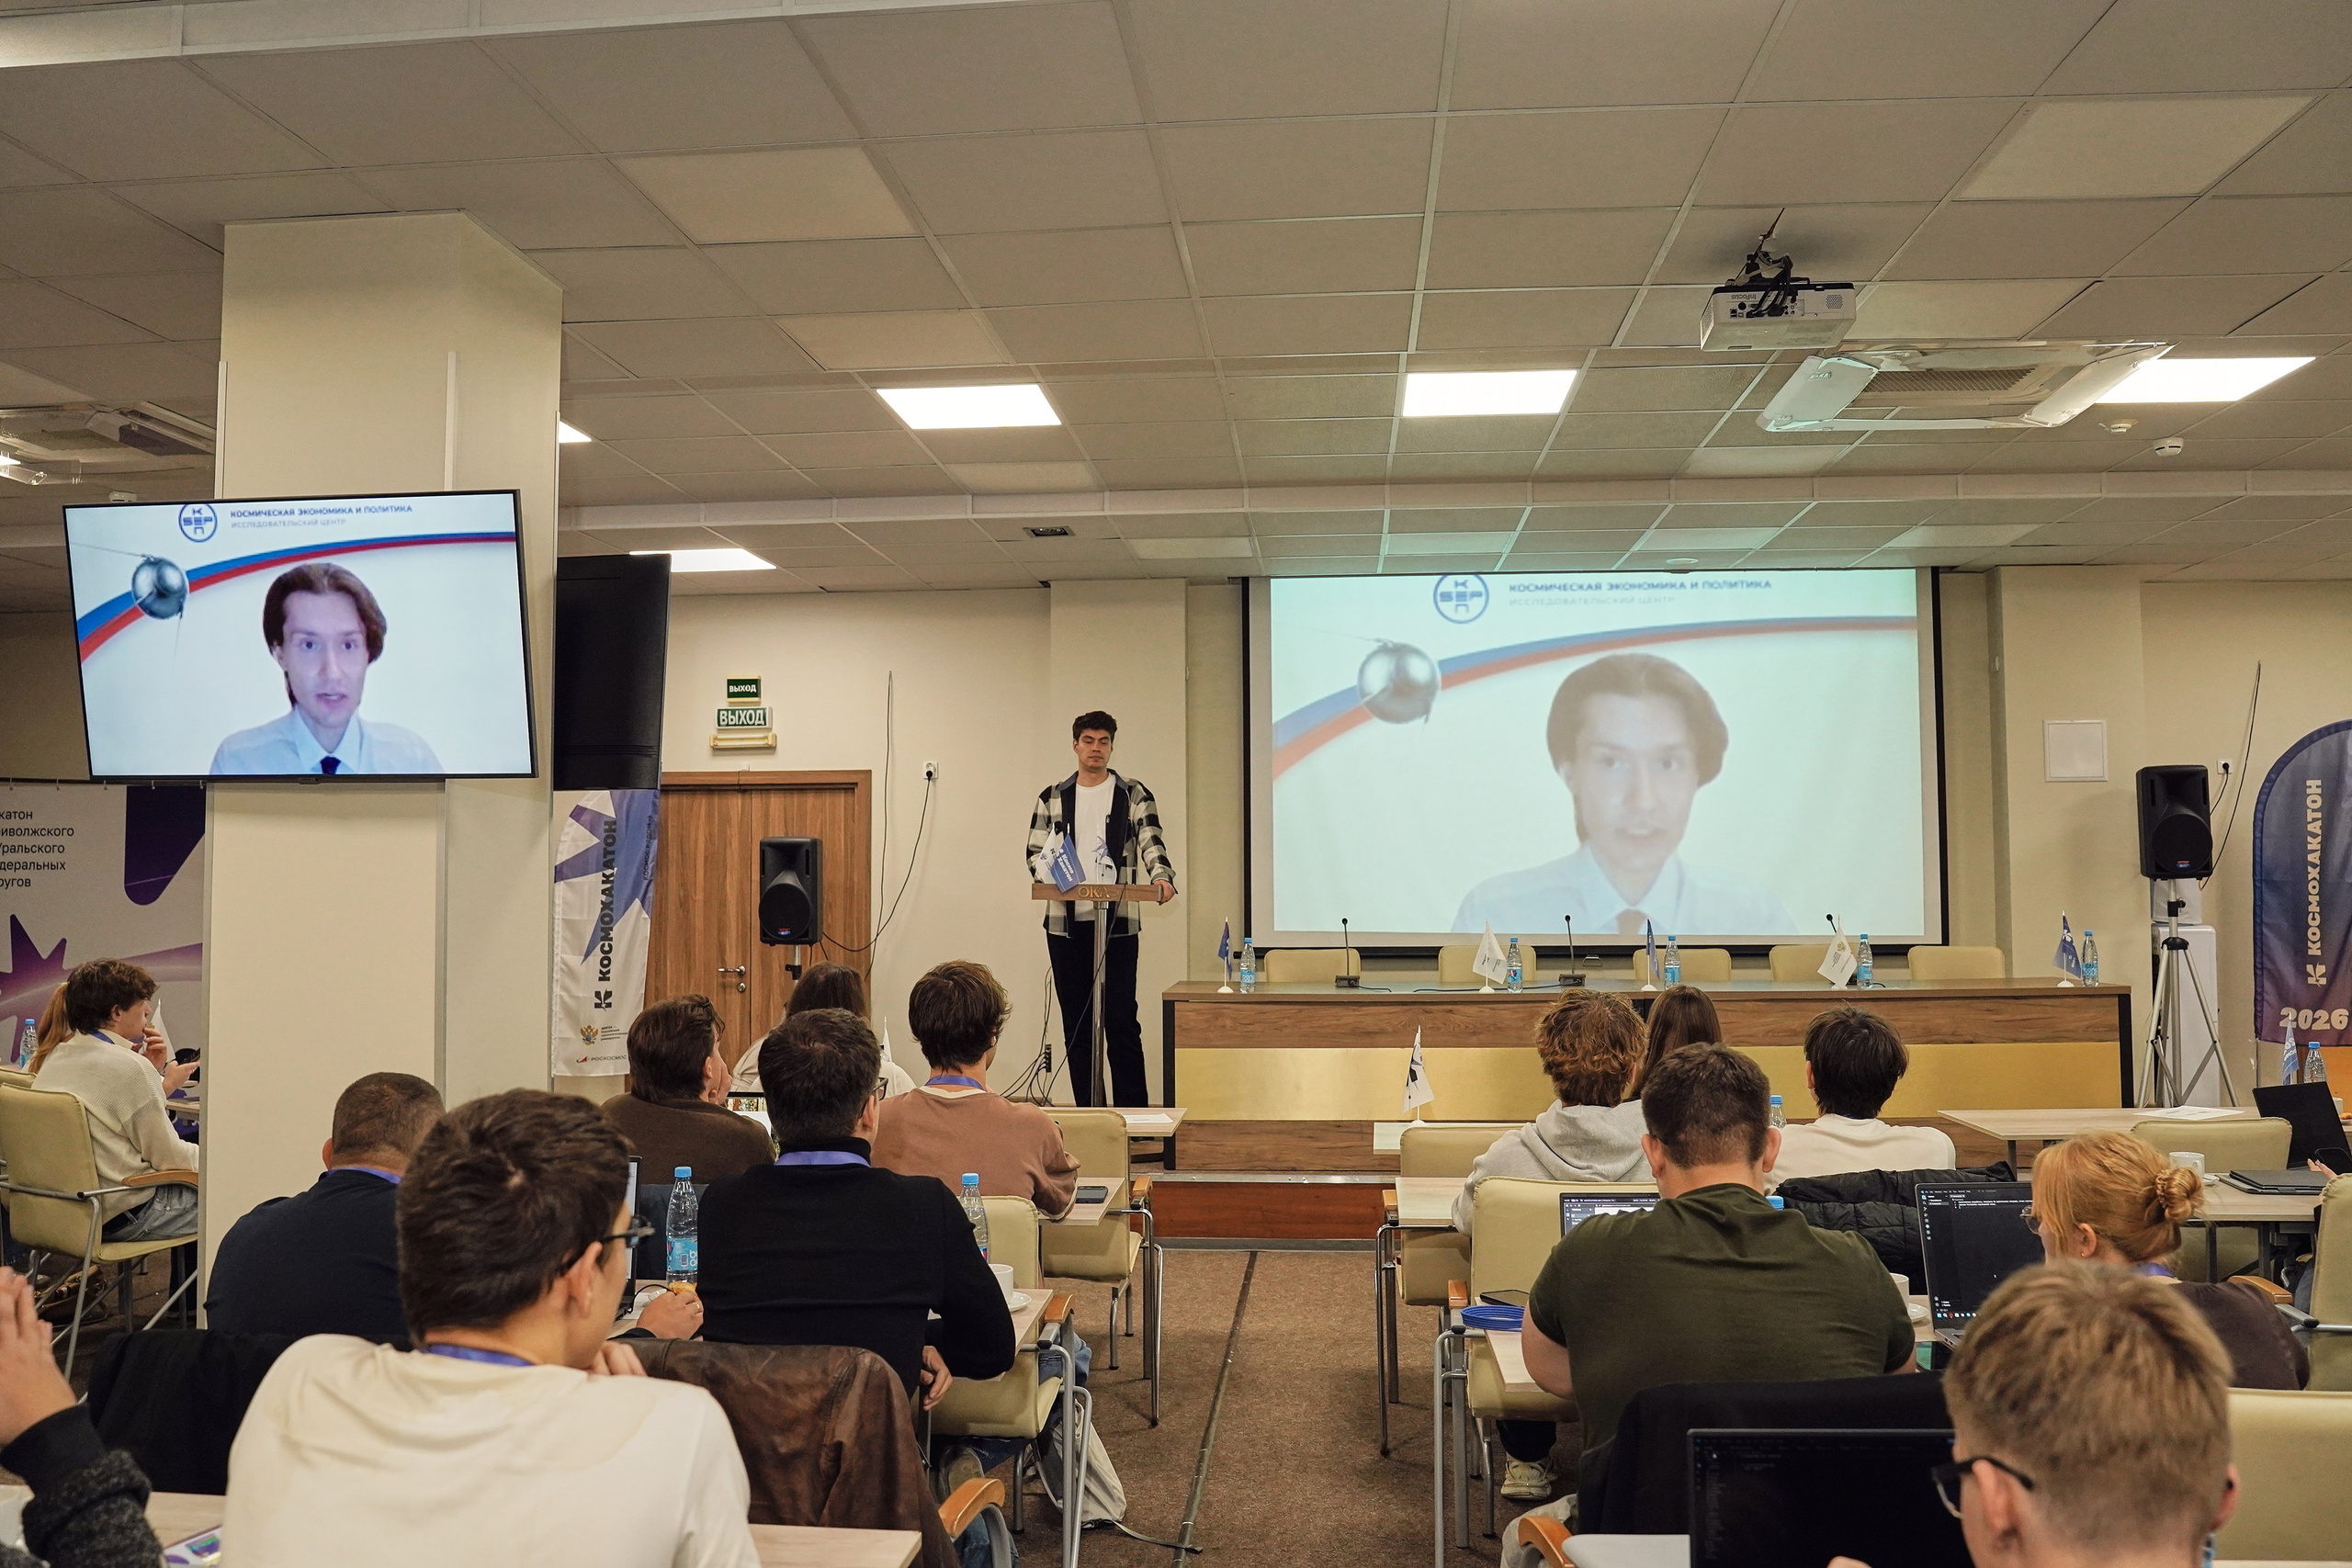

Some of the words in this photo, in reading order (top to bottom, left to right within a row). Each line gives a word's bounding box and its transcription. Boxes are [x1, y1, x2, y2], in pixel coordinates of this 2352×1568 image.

[230, 508, 295, 518] КОСМИЧЕСКАЯ
[298, 506, 354, 516] ЭКОНОМИКА
[356, 506, 362, 514] И
[364, 504, 413, 514] ПОЛИТИКА
[231, 519, 318, 529] ИССЛЕДОВАТЕЛЬСКИЙ
[320, 518, 346, 526] ЦЕНТР
[1509, 581, 1602, 592] КОСМИЧЕСКАЯ
[1607, 581, 1687, 592] ЭКОНОМИКА
[1690, 581, 1699, 590] И
[1702, 580, 1771, 590] ПОЛИТИКА
[729, 684, 757, 693] ВЫХОД
[719, 709, 764, 726] ВЫХОД
[2306, 779, 2322, 956] КОСМОХАКАТОН
[599, 820, 616, 982] КОСМОХАКАТОН
[2278, 1006, 2349, 1031] 2026
